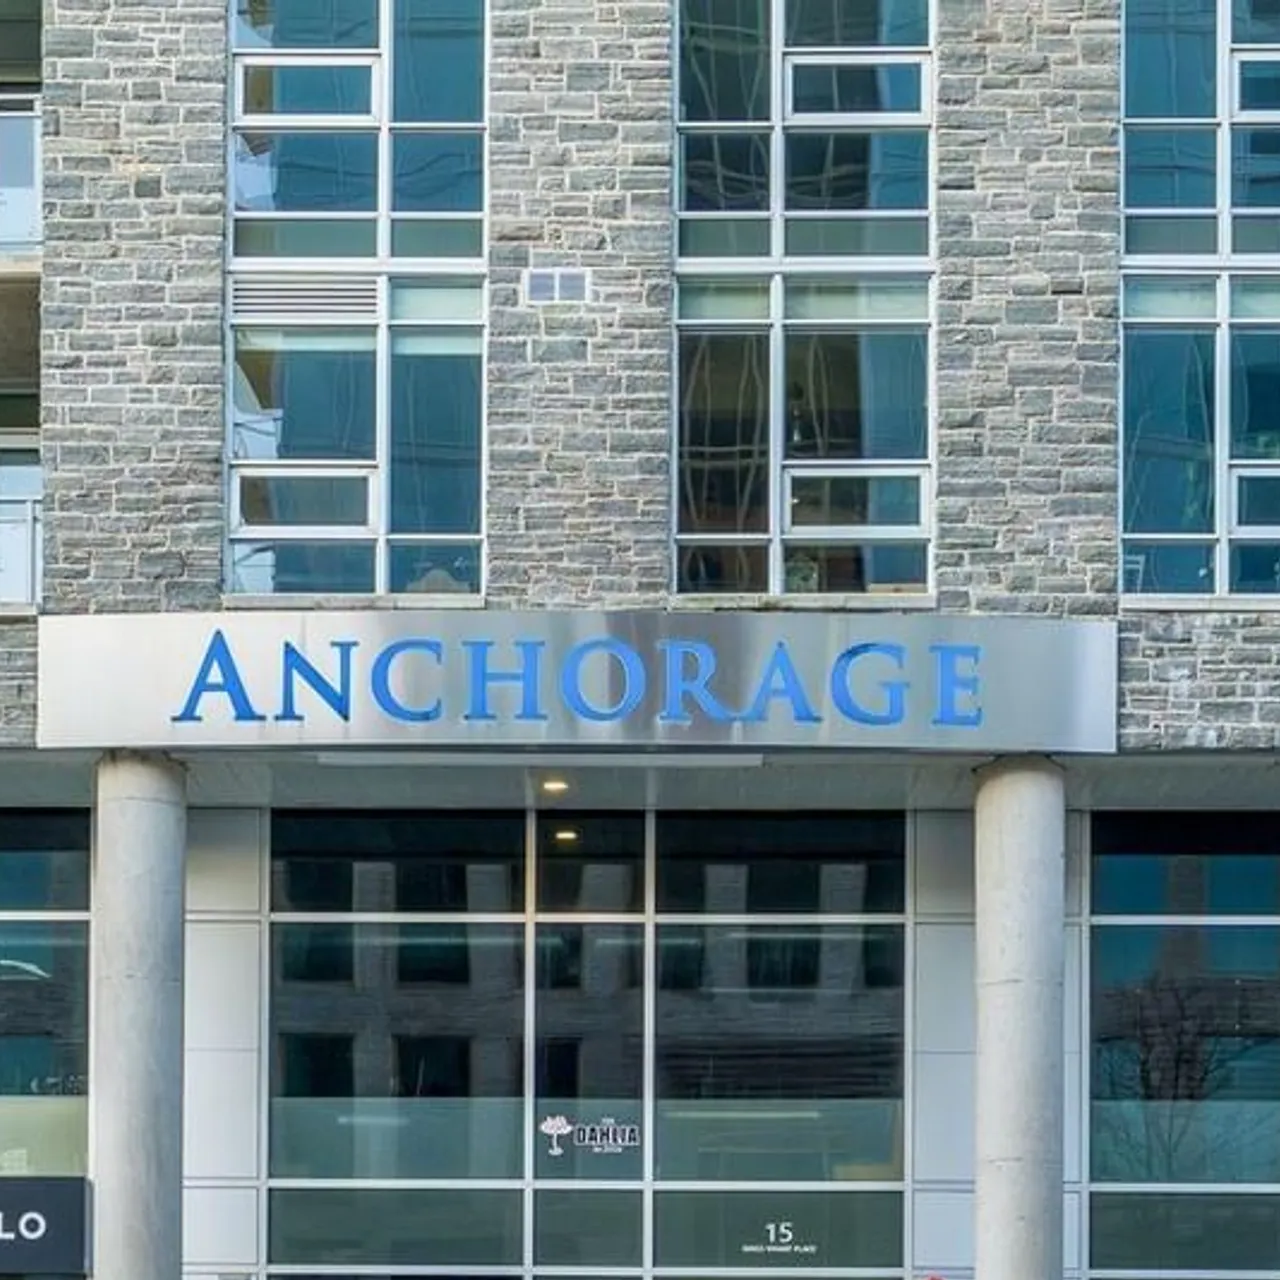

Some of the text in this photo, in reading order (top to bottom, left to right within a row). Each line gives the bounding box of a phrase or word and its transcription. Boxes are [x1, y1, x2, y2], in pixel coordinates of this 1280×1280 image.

[172, 629, 987, 729] ANCHORAGE
[574, 1125, 639, 1146] DAHLIA
[765, 1222, 793, 1243] 15
